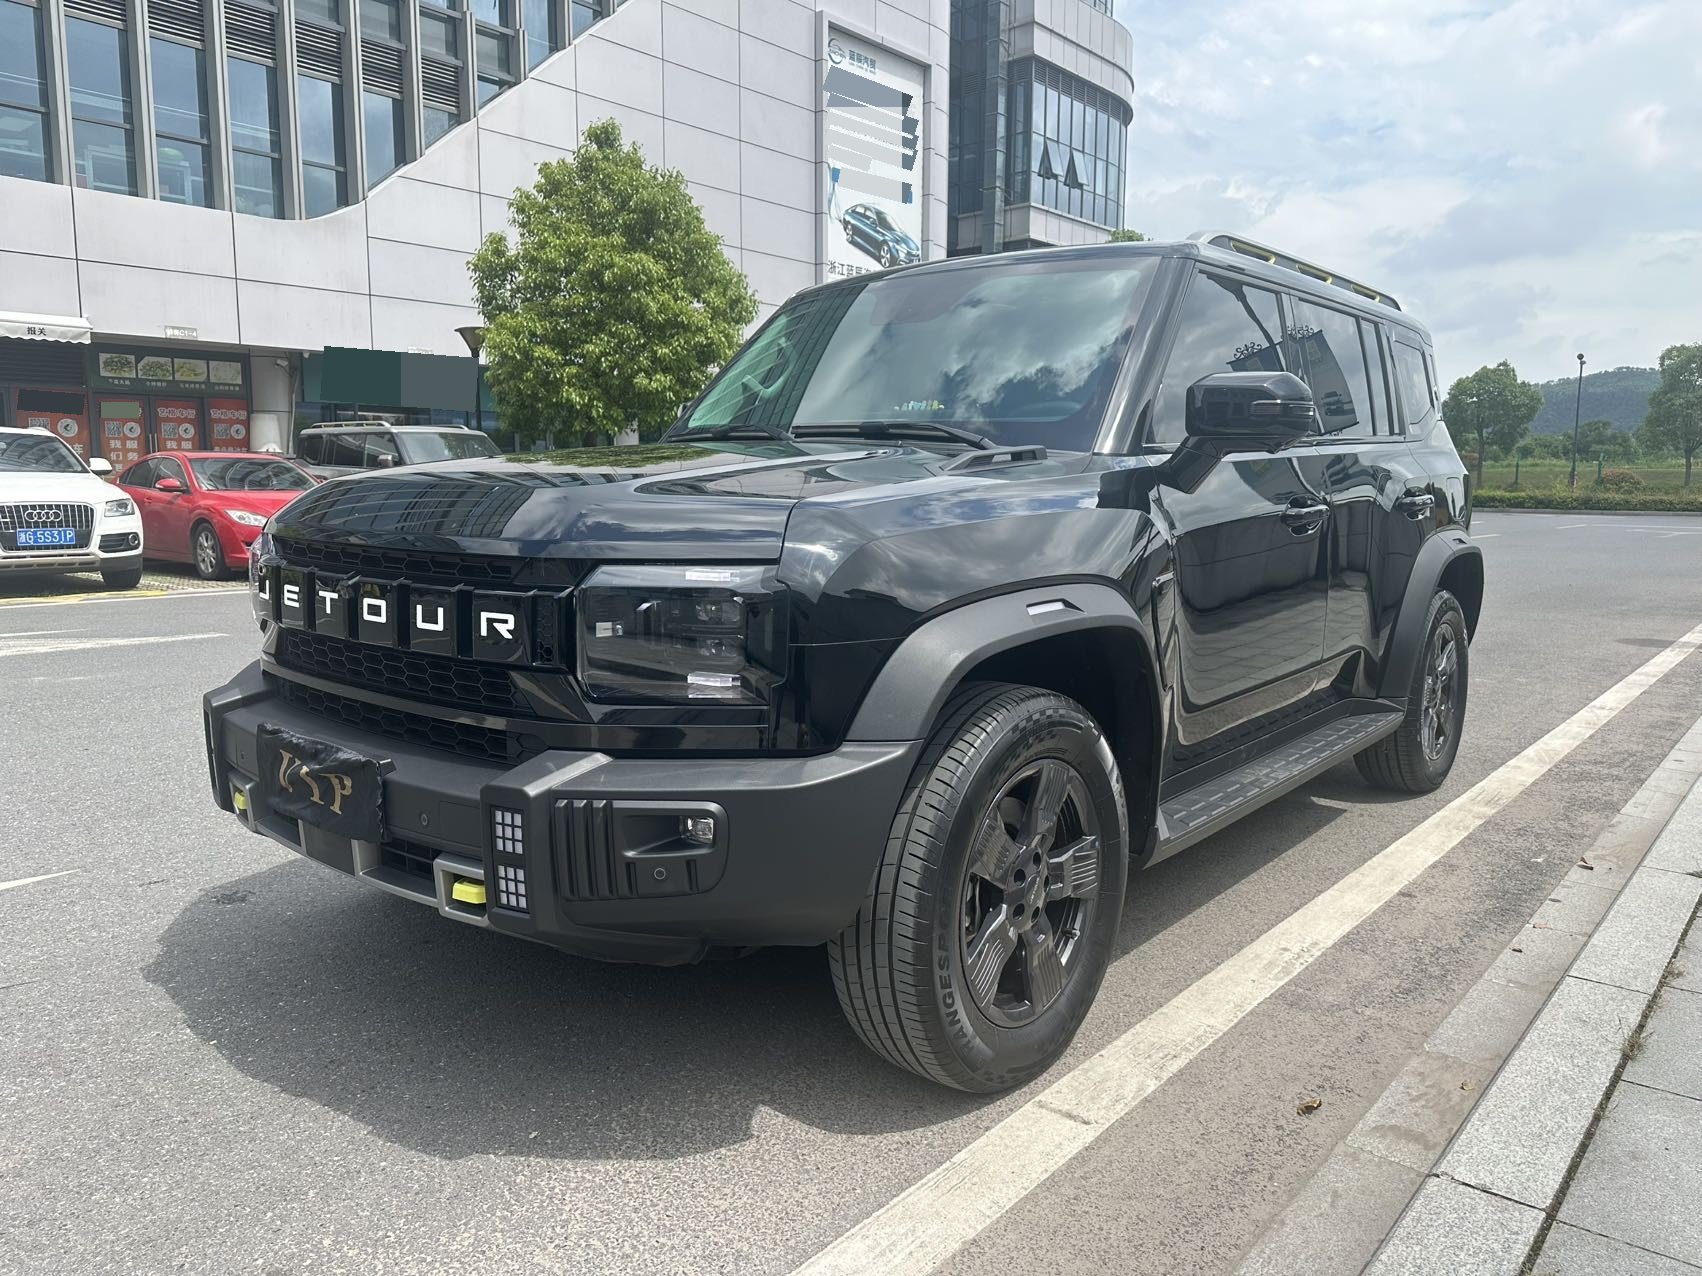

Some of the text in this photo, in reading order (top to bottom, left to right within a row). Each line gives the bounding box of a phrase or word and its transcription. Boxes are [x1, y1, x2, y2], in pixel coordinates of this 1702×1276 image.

[27, 326, 47, 336] 报关
[259, 580, 515, 639] JETOUR
[280, 749, 352, 814] VIP
